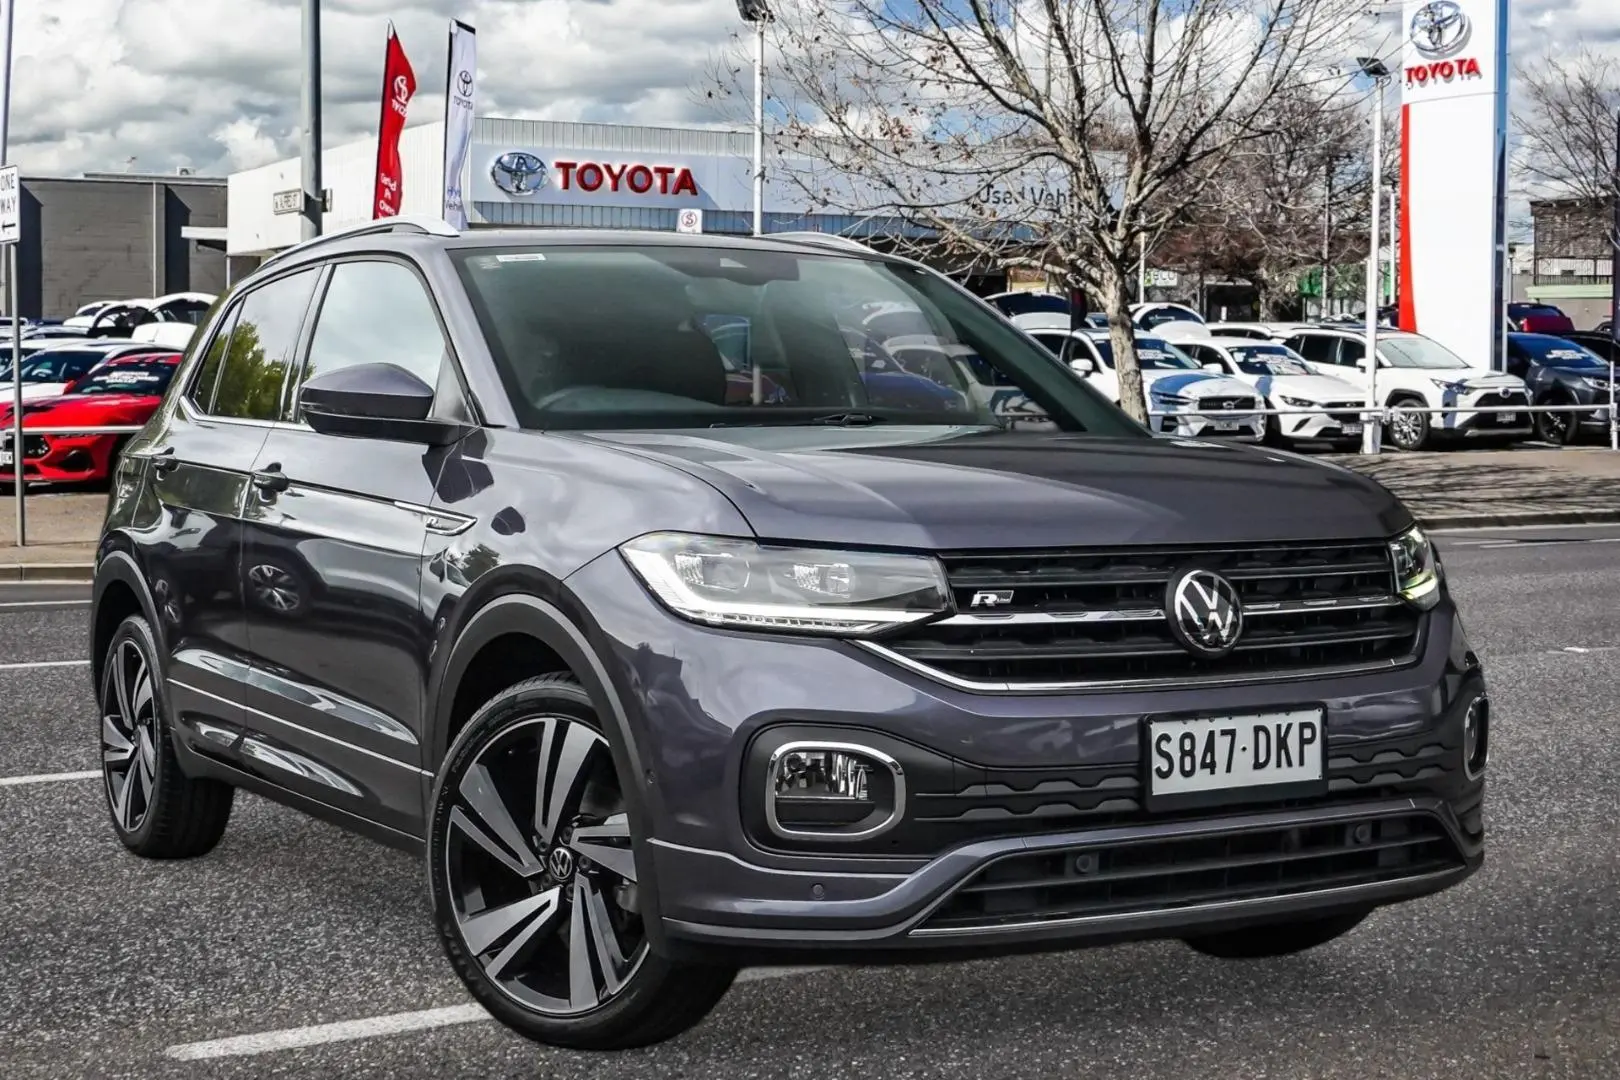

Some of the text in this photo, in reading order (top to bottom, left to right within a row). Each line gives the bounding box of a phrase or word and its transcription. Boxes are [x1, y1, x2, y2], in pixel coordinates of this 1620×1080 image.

[1404, 58, 1481, 83] TOYOTA
[0, 173, 15, 192] ONE
[554, 162, 698, 196] TOYOTA
[0, 196, 17, 216] WAY
